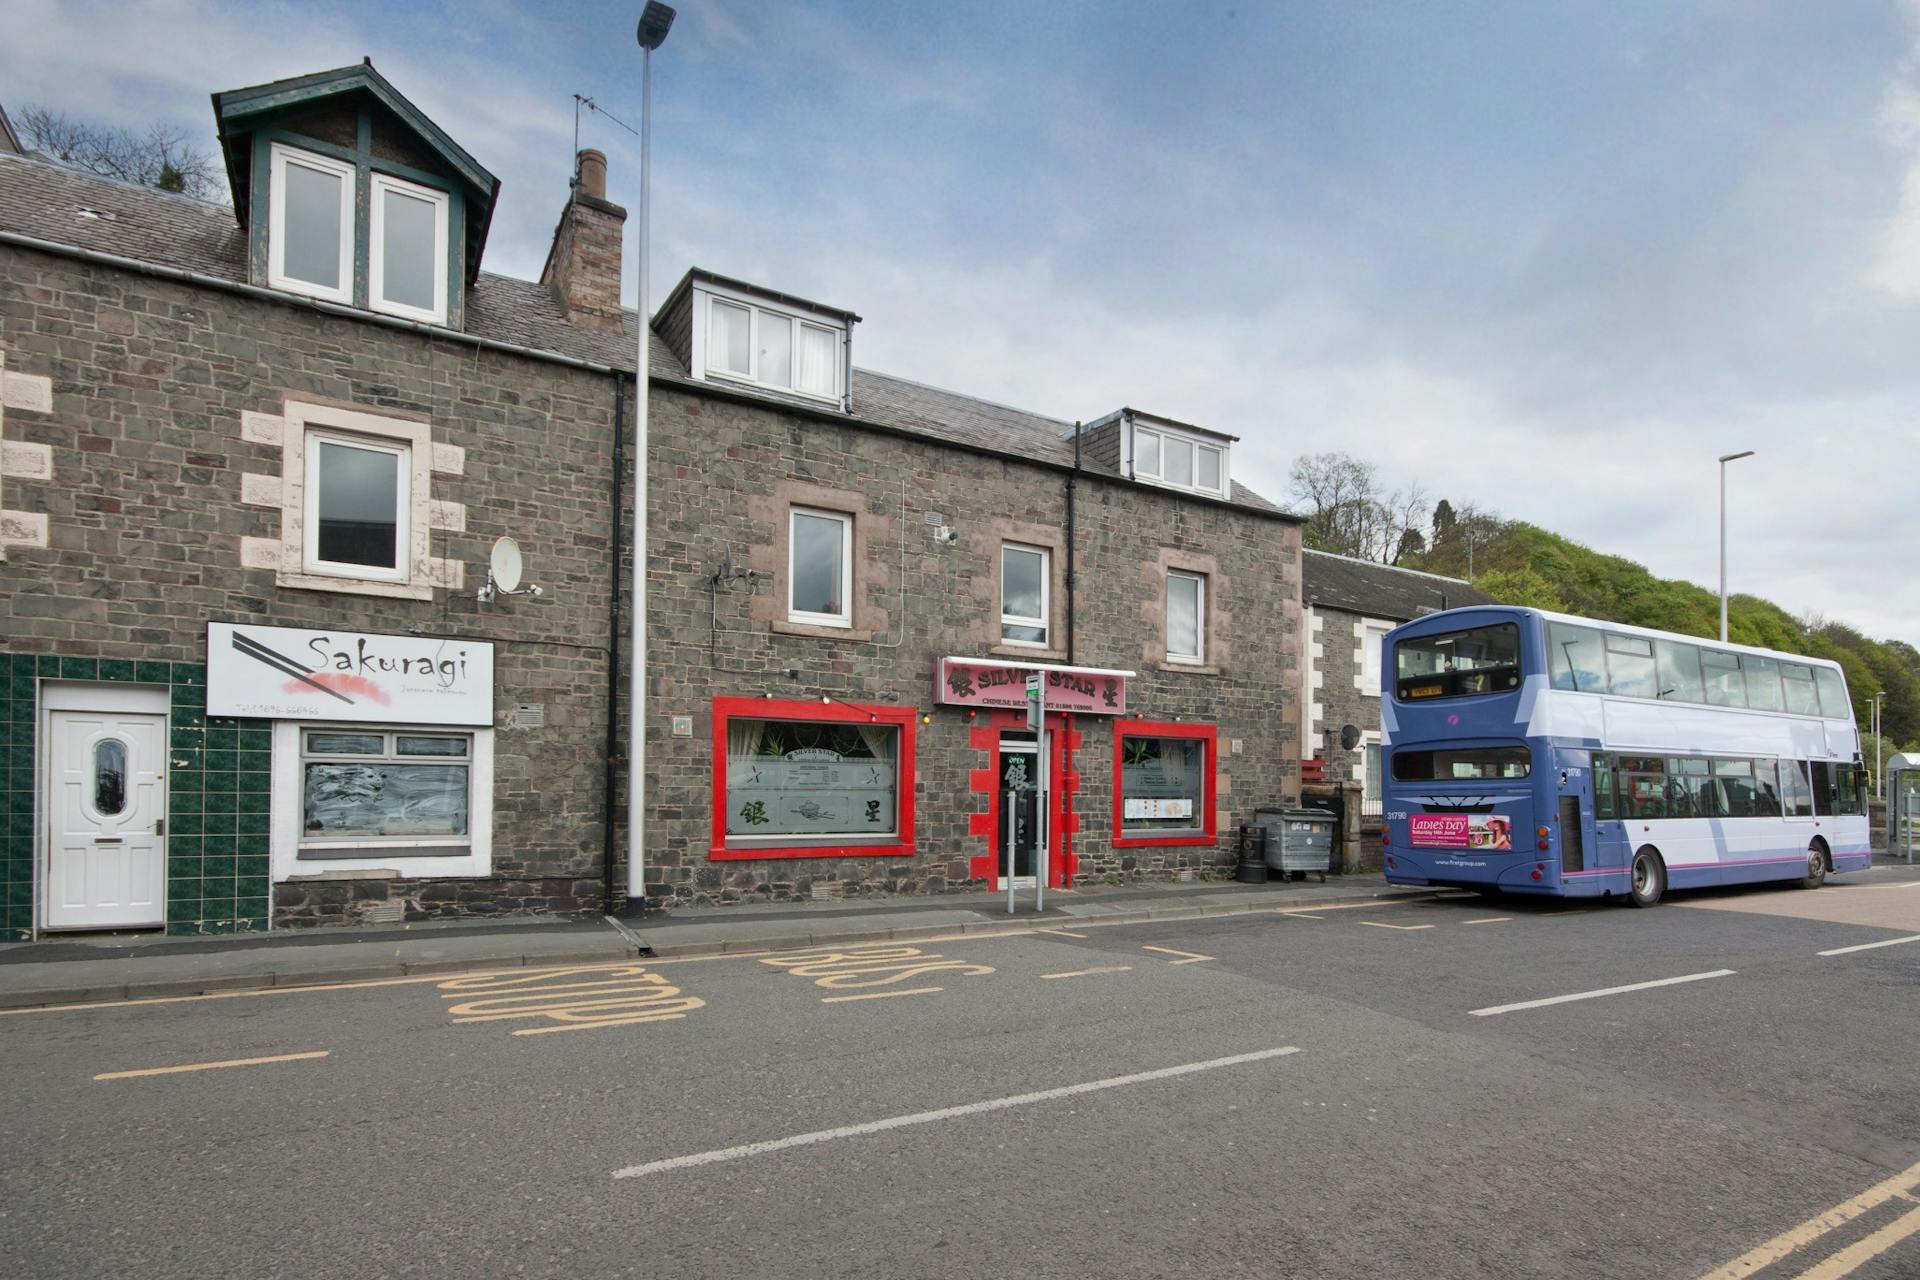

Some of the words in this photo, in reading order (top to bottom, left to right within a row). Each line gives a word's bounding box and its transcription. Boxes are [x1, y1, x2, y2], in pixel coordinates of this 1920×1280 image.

[309, 636, 467, 688] Sakuragi
[977, 668, 1037, 689] SILVE
[1049, 671, 1096, 697] STAR
[1008, 756, 1025, 765] OPEN
[740, 800, 770, 826] 銀
[758, 946, 997, 990] BUS
[436, 966, 706, 1023] STOP
